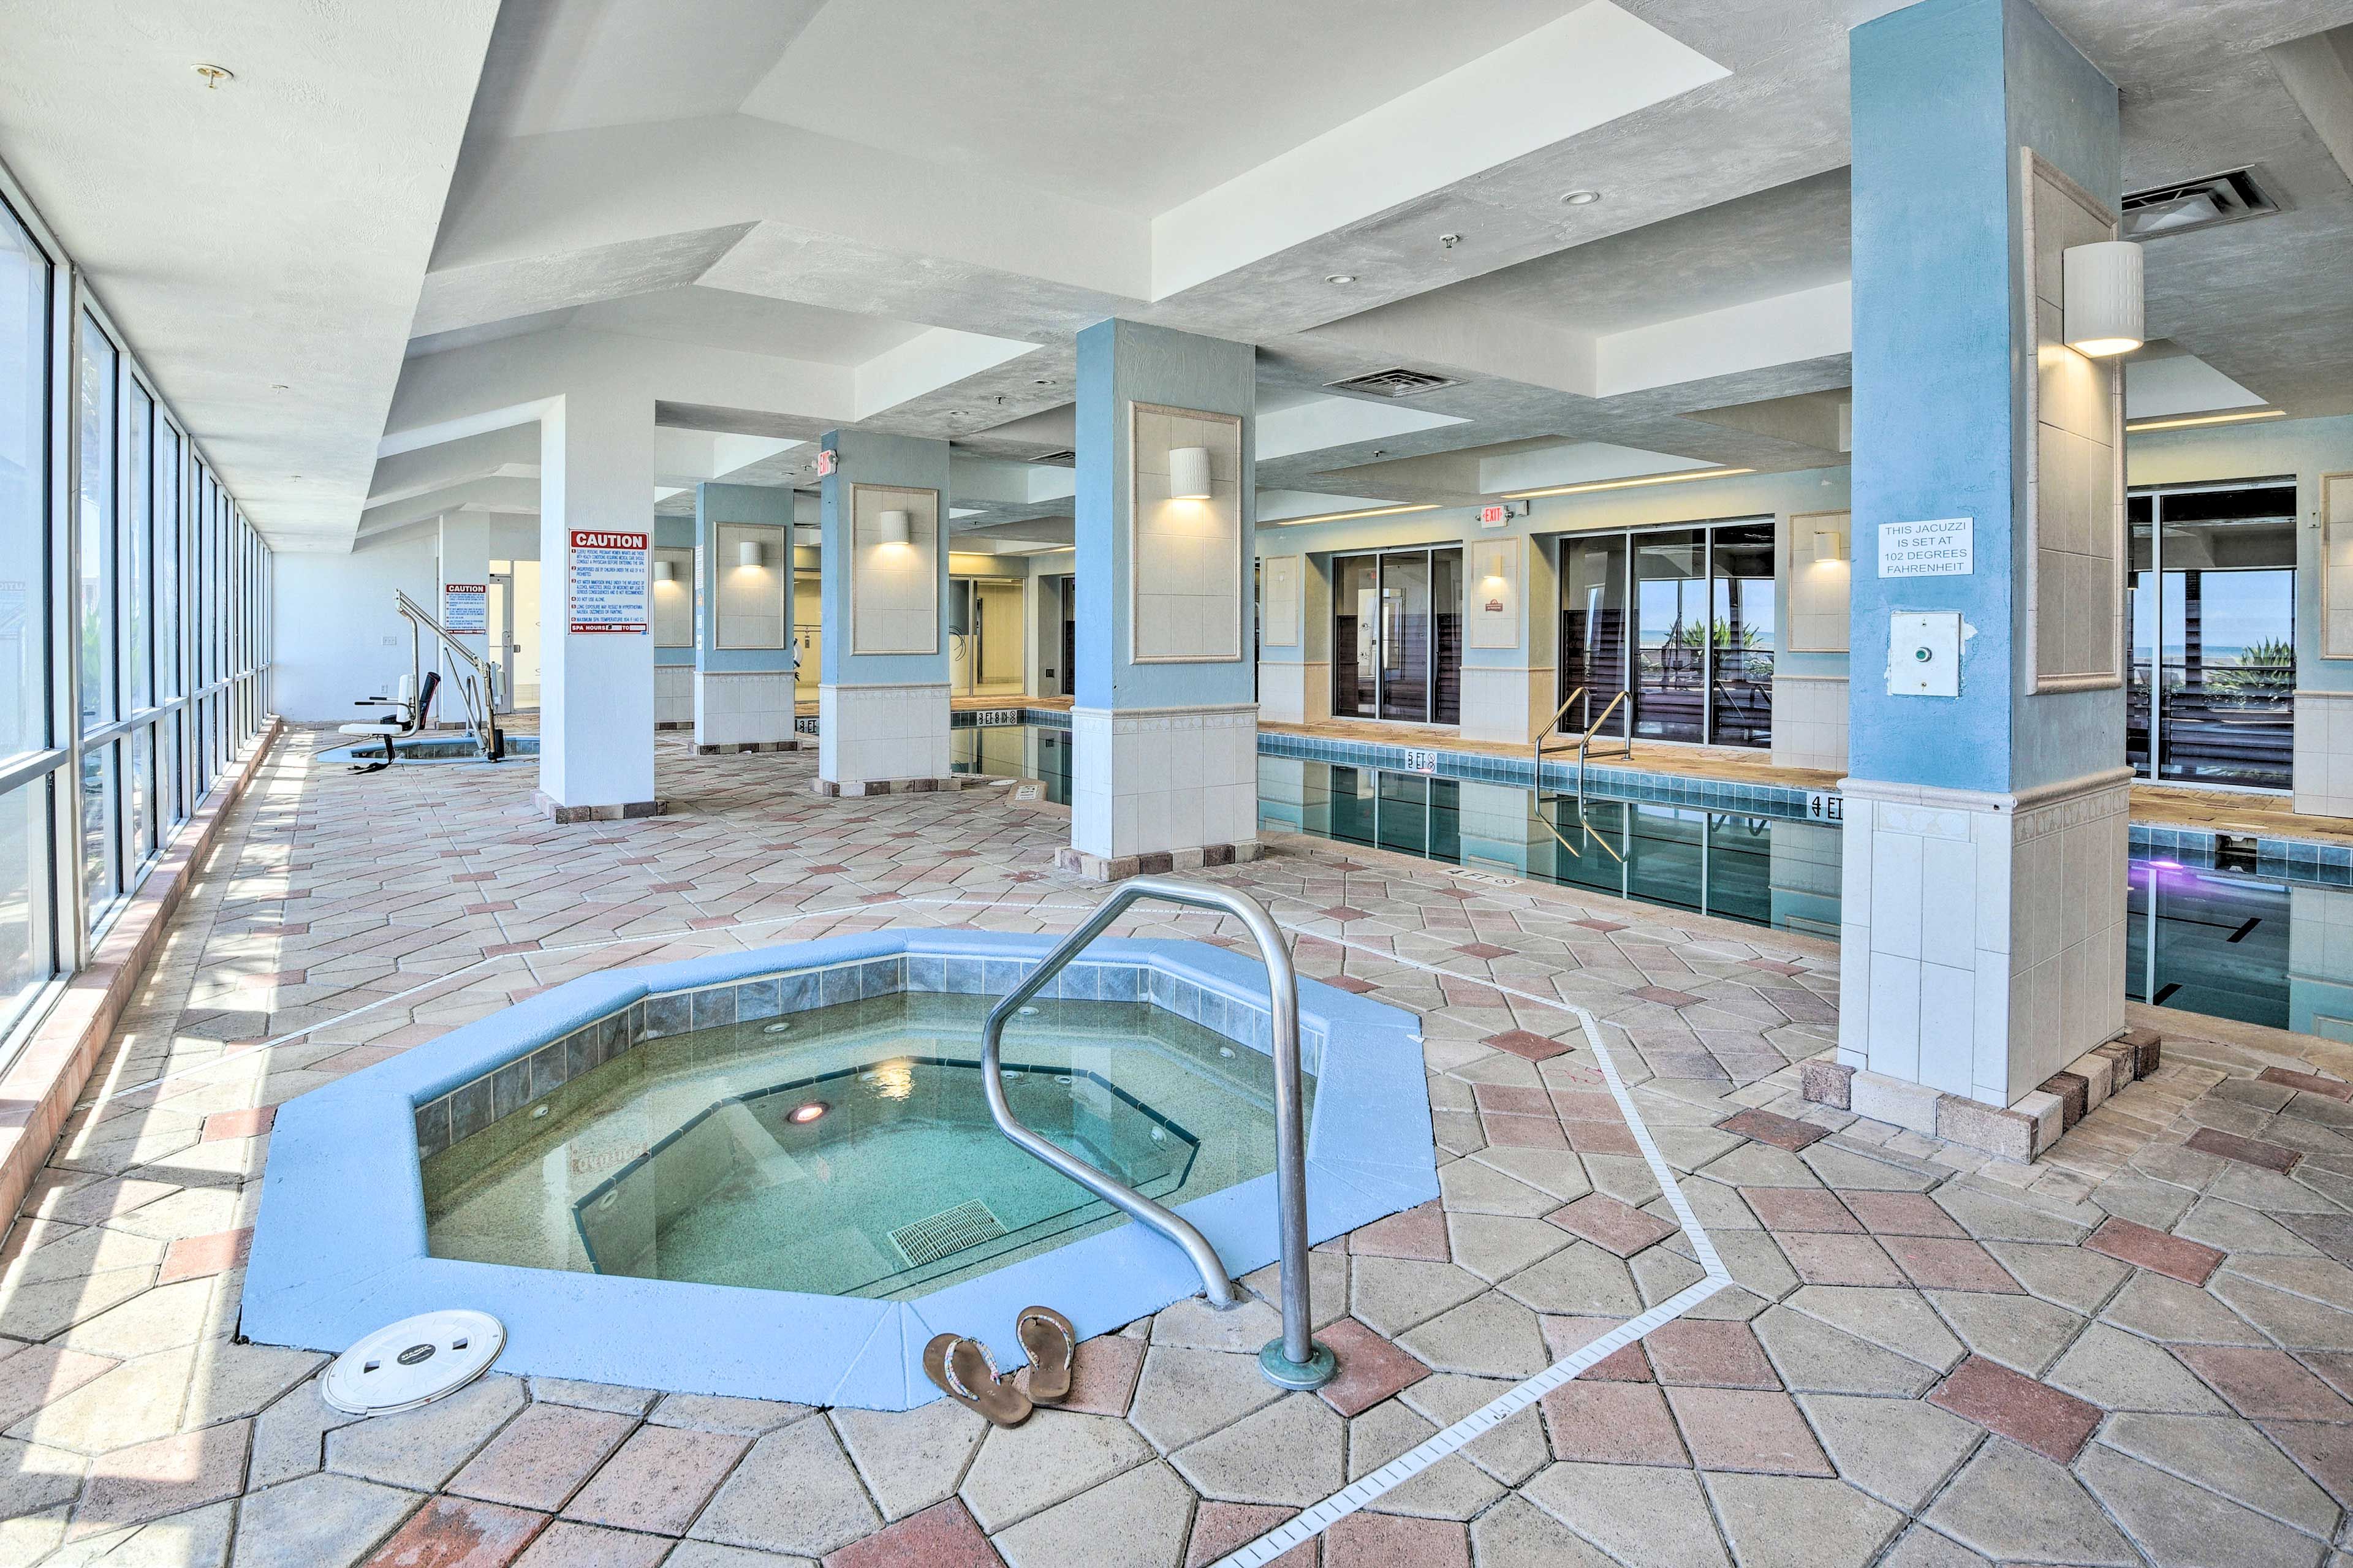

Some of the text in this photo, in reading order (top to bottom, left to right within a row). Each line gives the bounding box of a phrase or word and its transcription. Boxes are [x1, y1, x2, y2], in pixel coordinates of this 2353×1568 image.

[1485, 508, 1500, 521] EXIT
[1885, 522, 1966, 535] THIS JACUZZI
[576, 533, 642, 548] CAUTION
[1912, 537, 1936, 546] SET
[1938, 536, 1953, 545] AT
[1908, 549, 1967, 560] DEGREES
[1887, 562, 1964, 574] FAHRENHEIT
